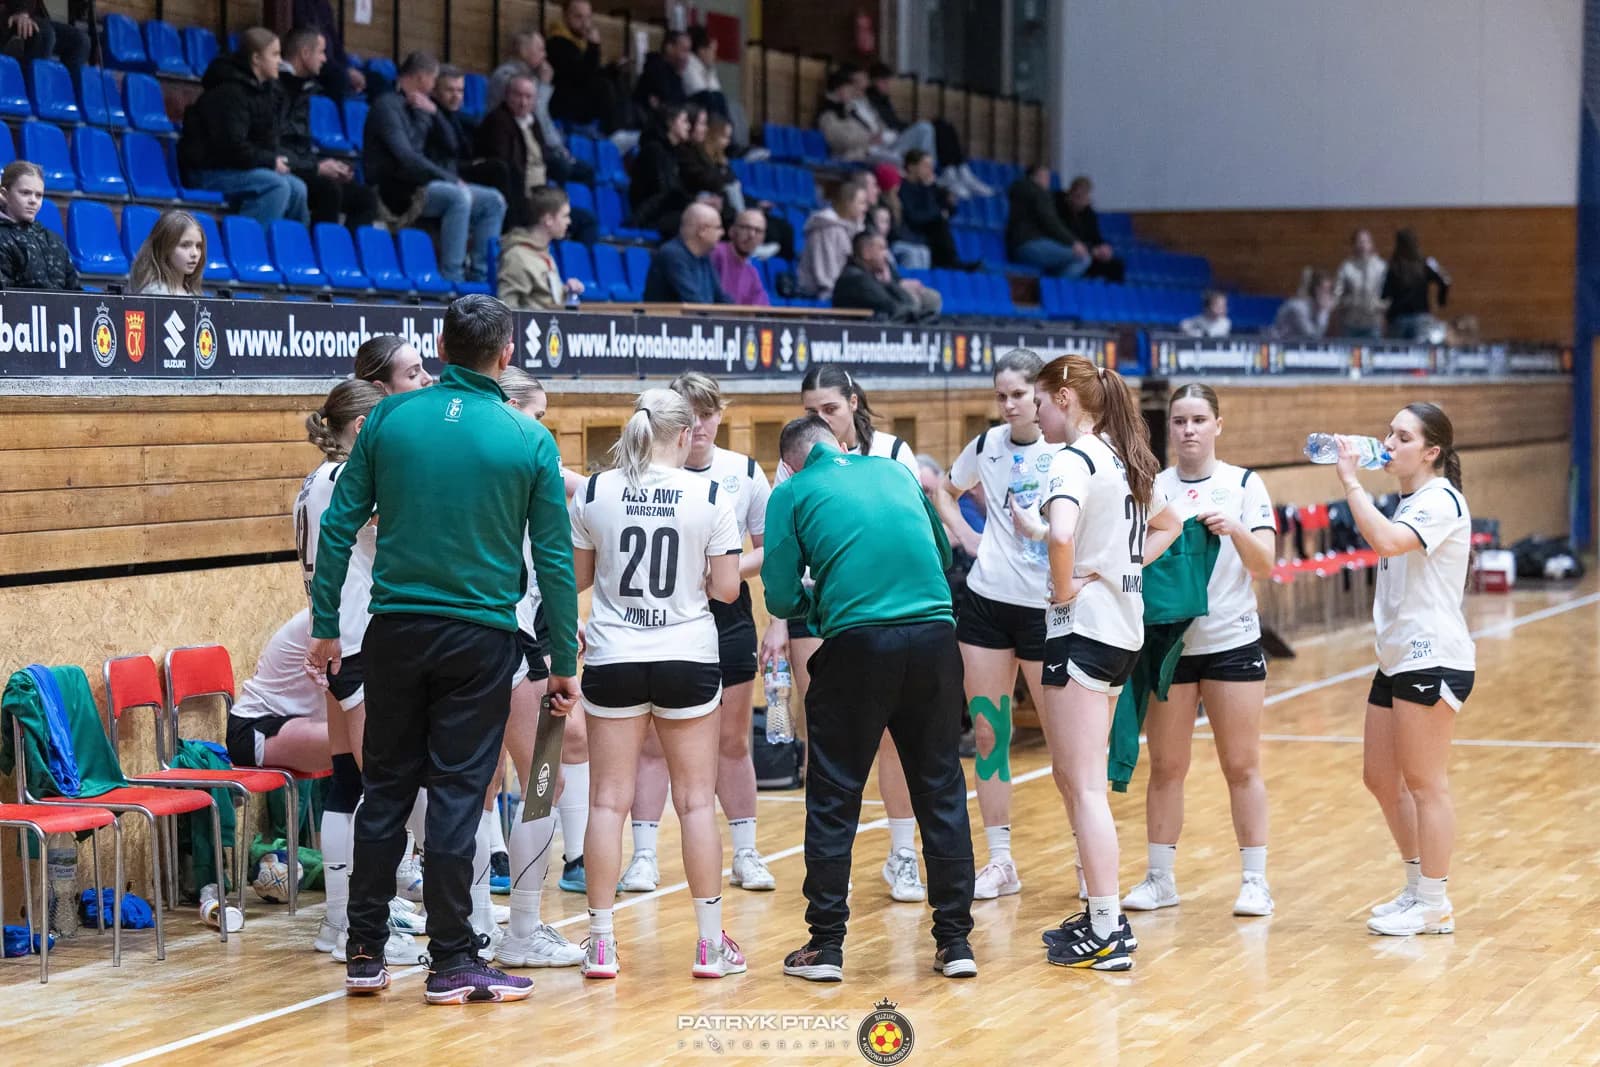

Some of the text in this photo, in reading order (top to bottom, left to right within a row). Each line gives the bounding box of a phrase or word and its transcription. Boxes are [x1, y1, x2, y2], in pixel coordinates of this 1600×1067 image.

[567, 320, 741, 372] www.koronahandball.pl
[163, 359, 187, 369] SUZUKI
[652, 488, 684, 504] AWF
[626, 505, 675, 517] WARSZAWA
[619, 525, 679, 598] 20
